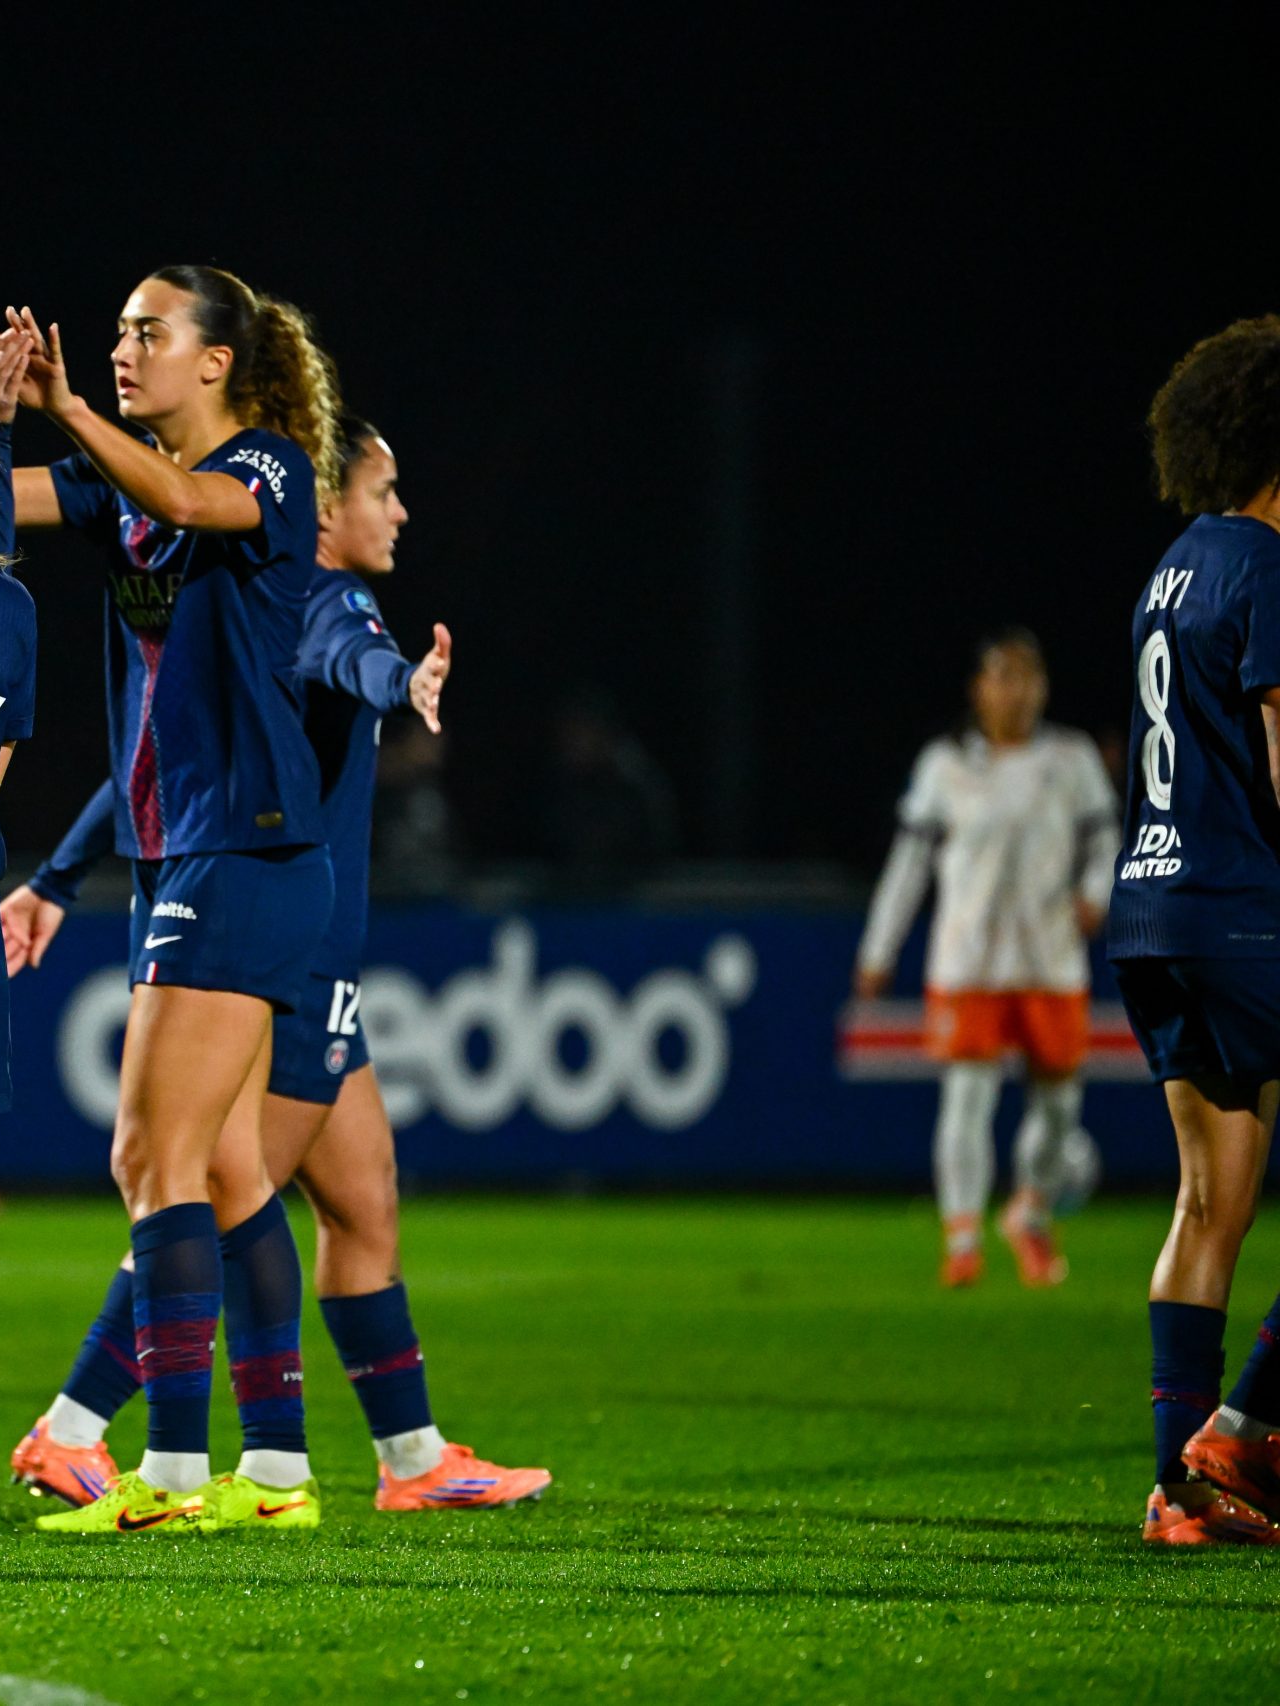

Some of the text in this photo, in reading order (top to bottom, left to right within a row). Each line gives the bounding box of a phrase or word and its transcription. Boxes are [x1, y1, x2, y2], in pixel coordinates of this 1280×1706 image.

[1145, 567, 1194, 613] AYI
[1138, 629, 1176, 811] 8
[56, 914, 730, 1132] oedoo
[326, 980, 361, 1035] 12
